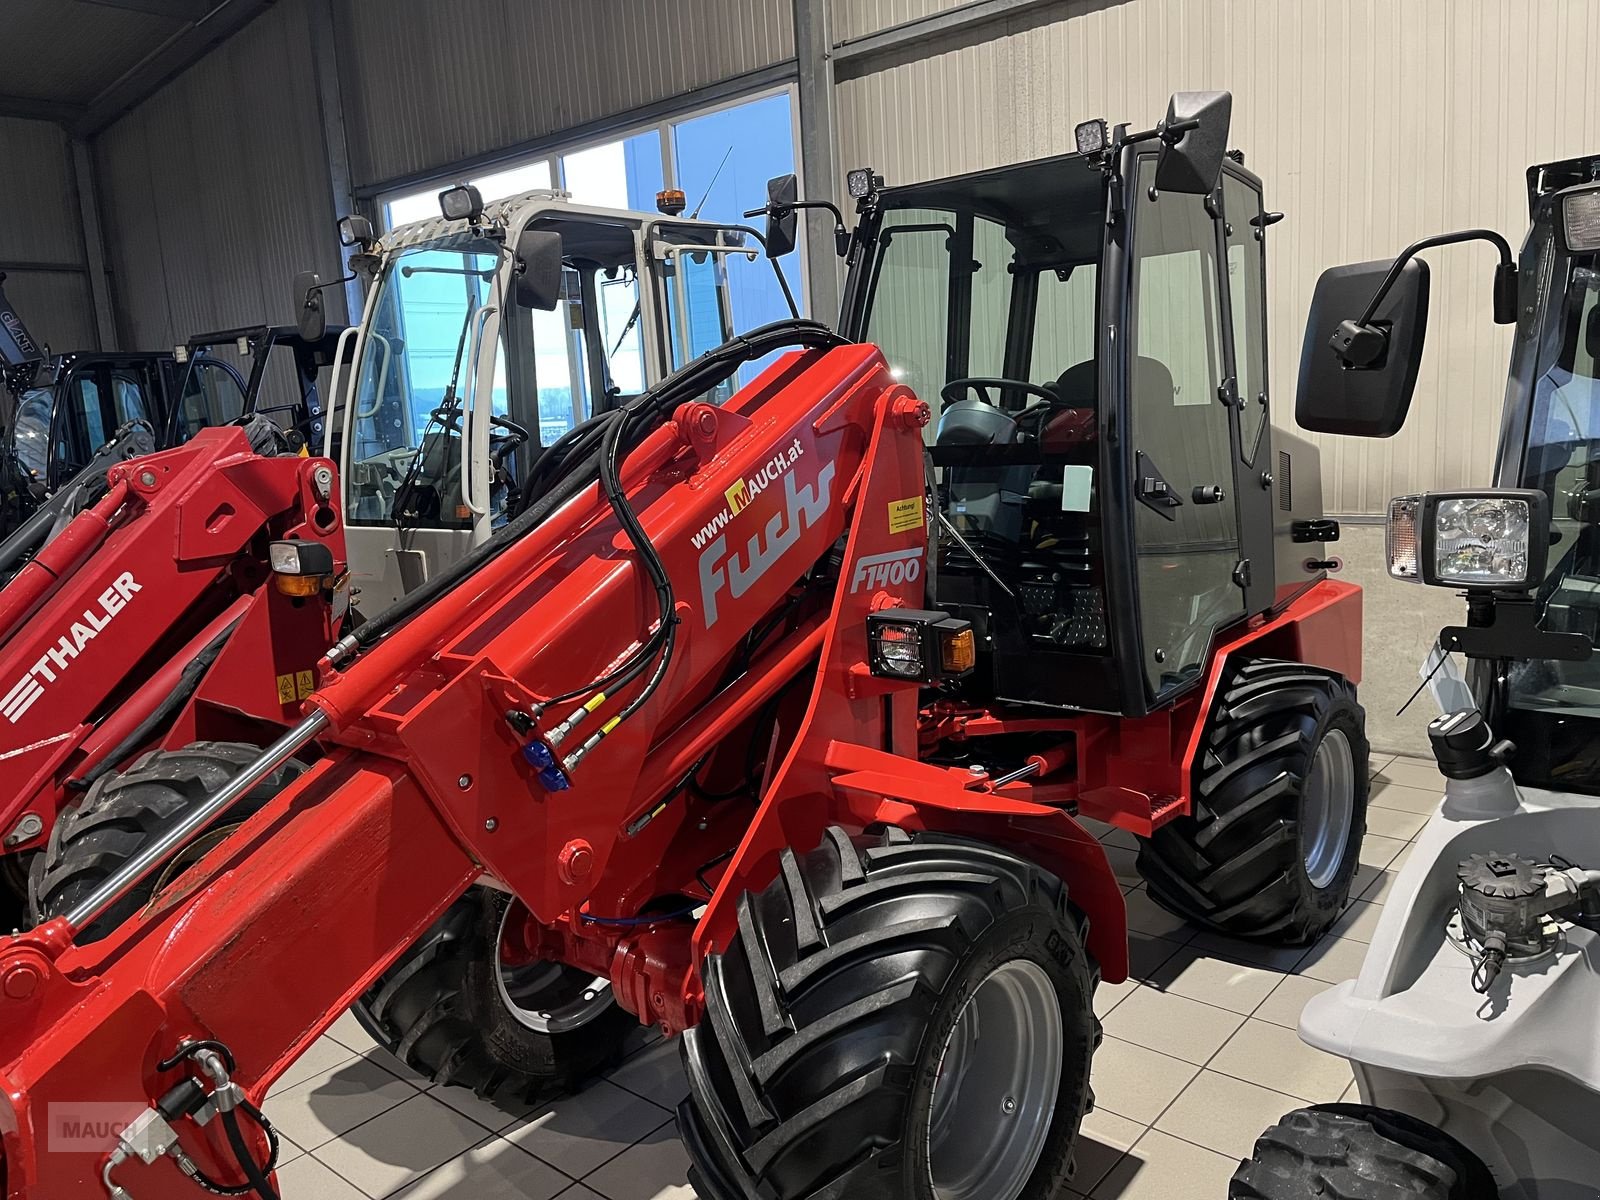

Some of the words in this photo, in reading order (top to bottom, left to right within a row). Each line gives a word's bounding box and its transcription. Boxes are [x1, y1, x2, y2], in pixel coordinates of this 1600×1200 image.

[1, 311, 35, 352] GIANT
[690, 438, 804, 549] www.MAUCH.at
[698, 460, 835, 630] Fuchs
[850, 547, 924, 594] F1400
